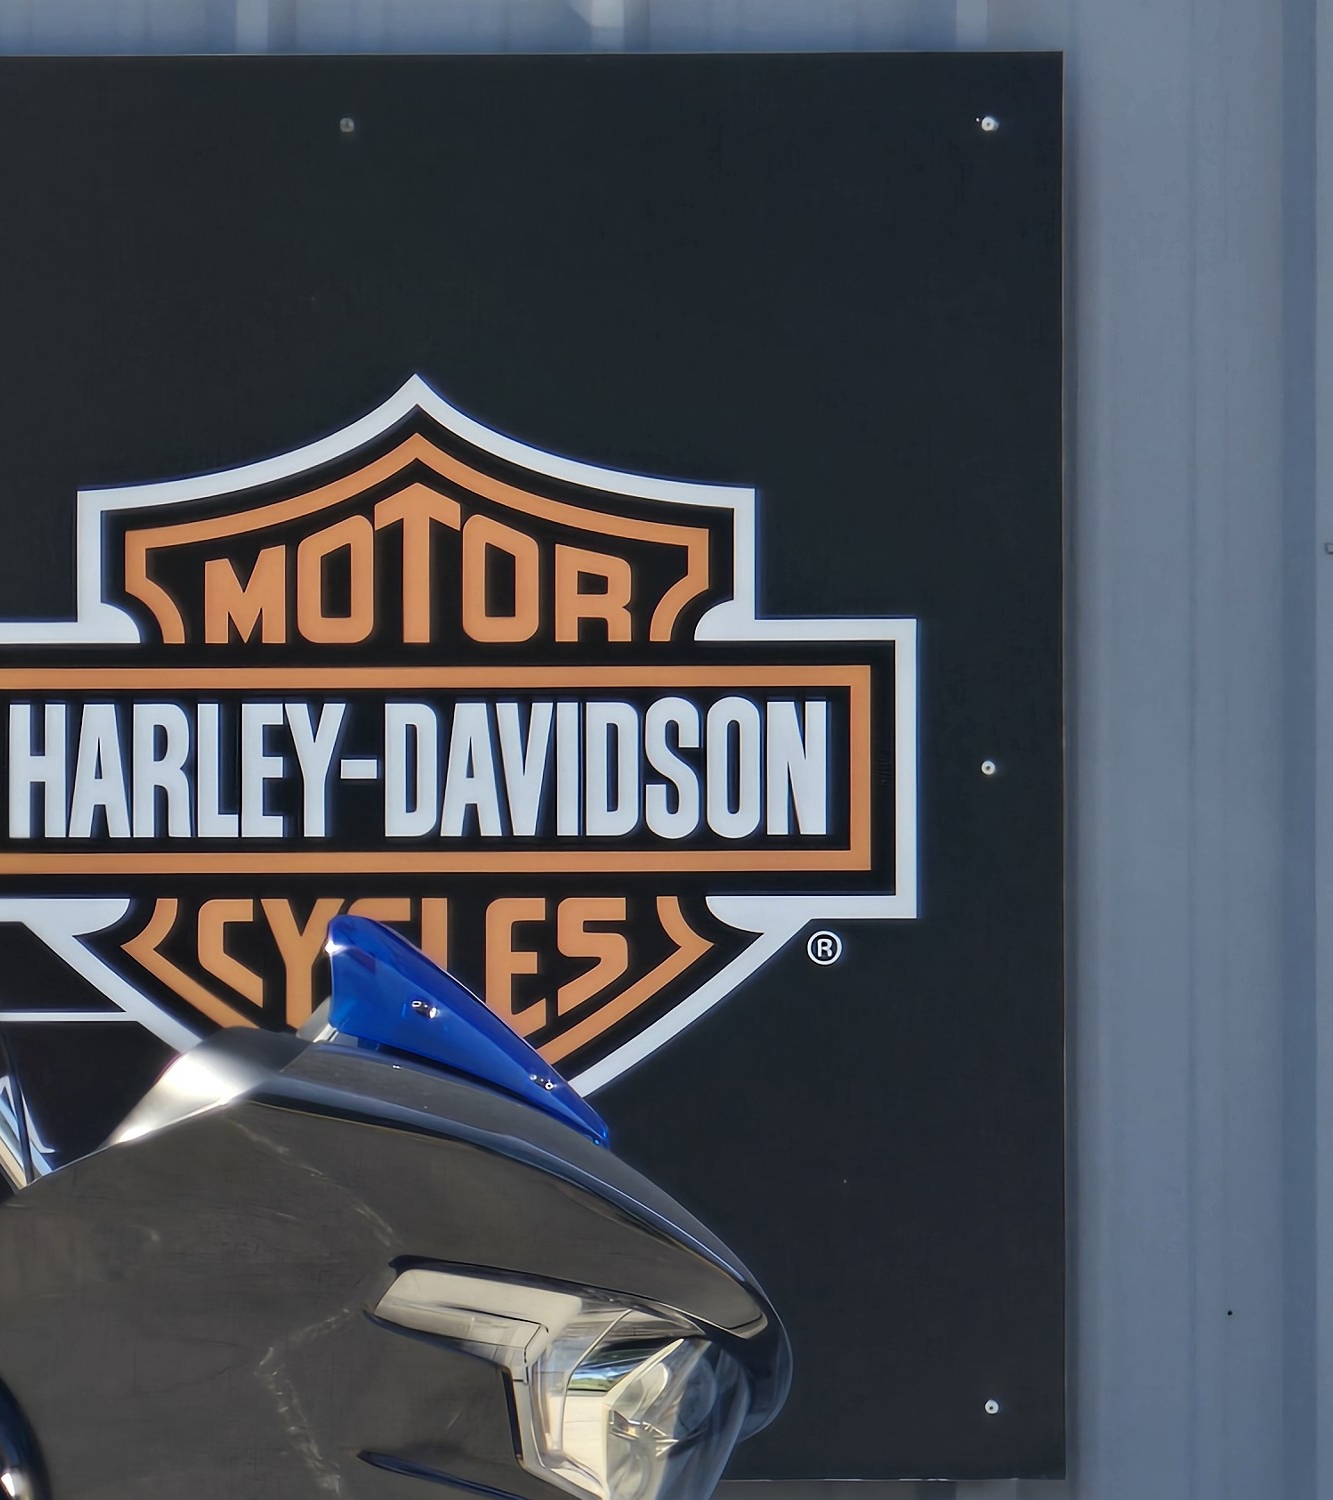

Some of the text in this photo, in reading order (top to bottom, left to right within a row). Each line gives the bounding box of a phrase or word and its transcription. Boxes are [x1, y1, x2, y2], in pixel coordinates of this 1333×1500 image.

[203, 482, 633, 644] MOTOR
[7, 696, 828, 840] HARLEY-DAVIDSON
[197, 897, 629, 1038] CYES
